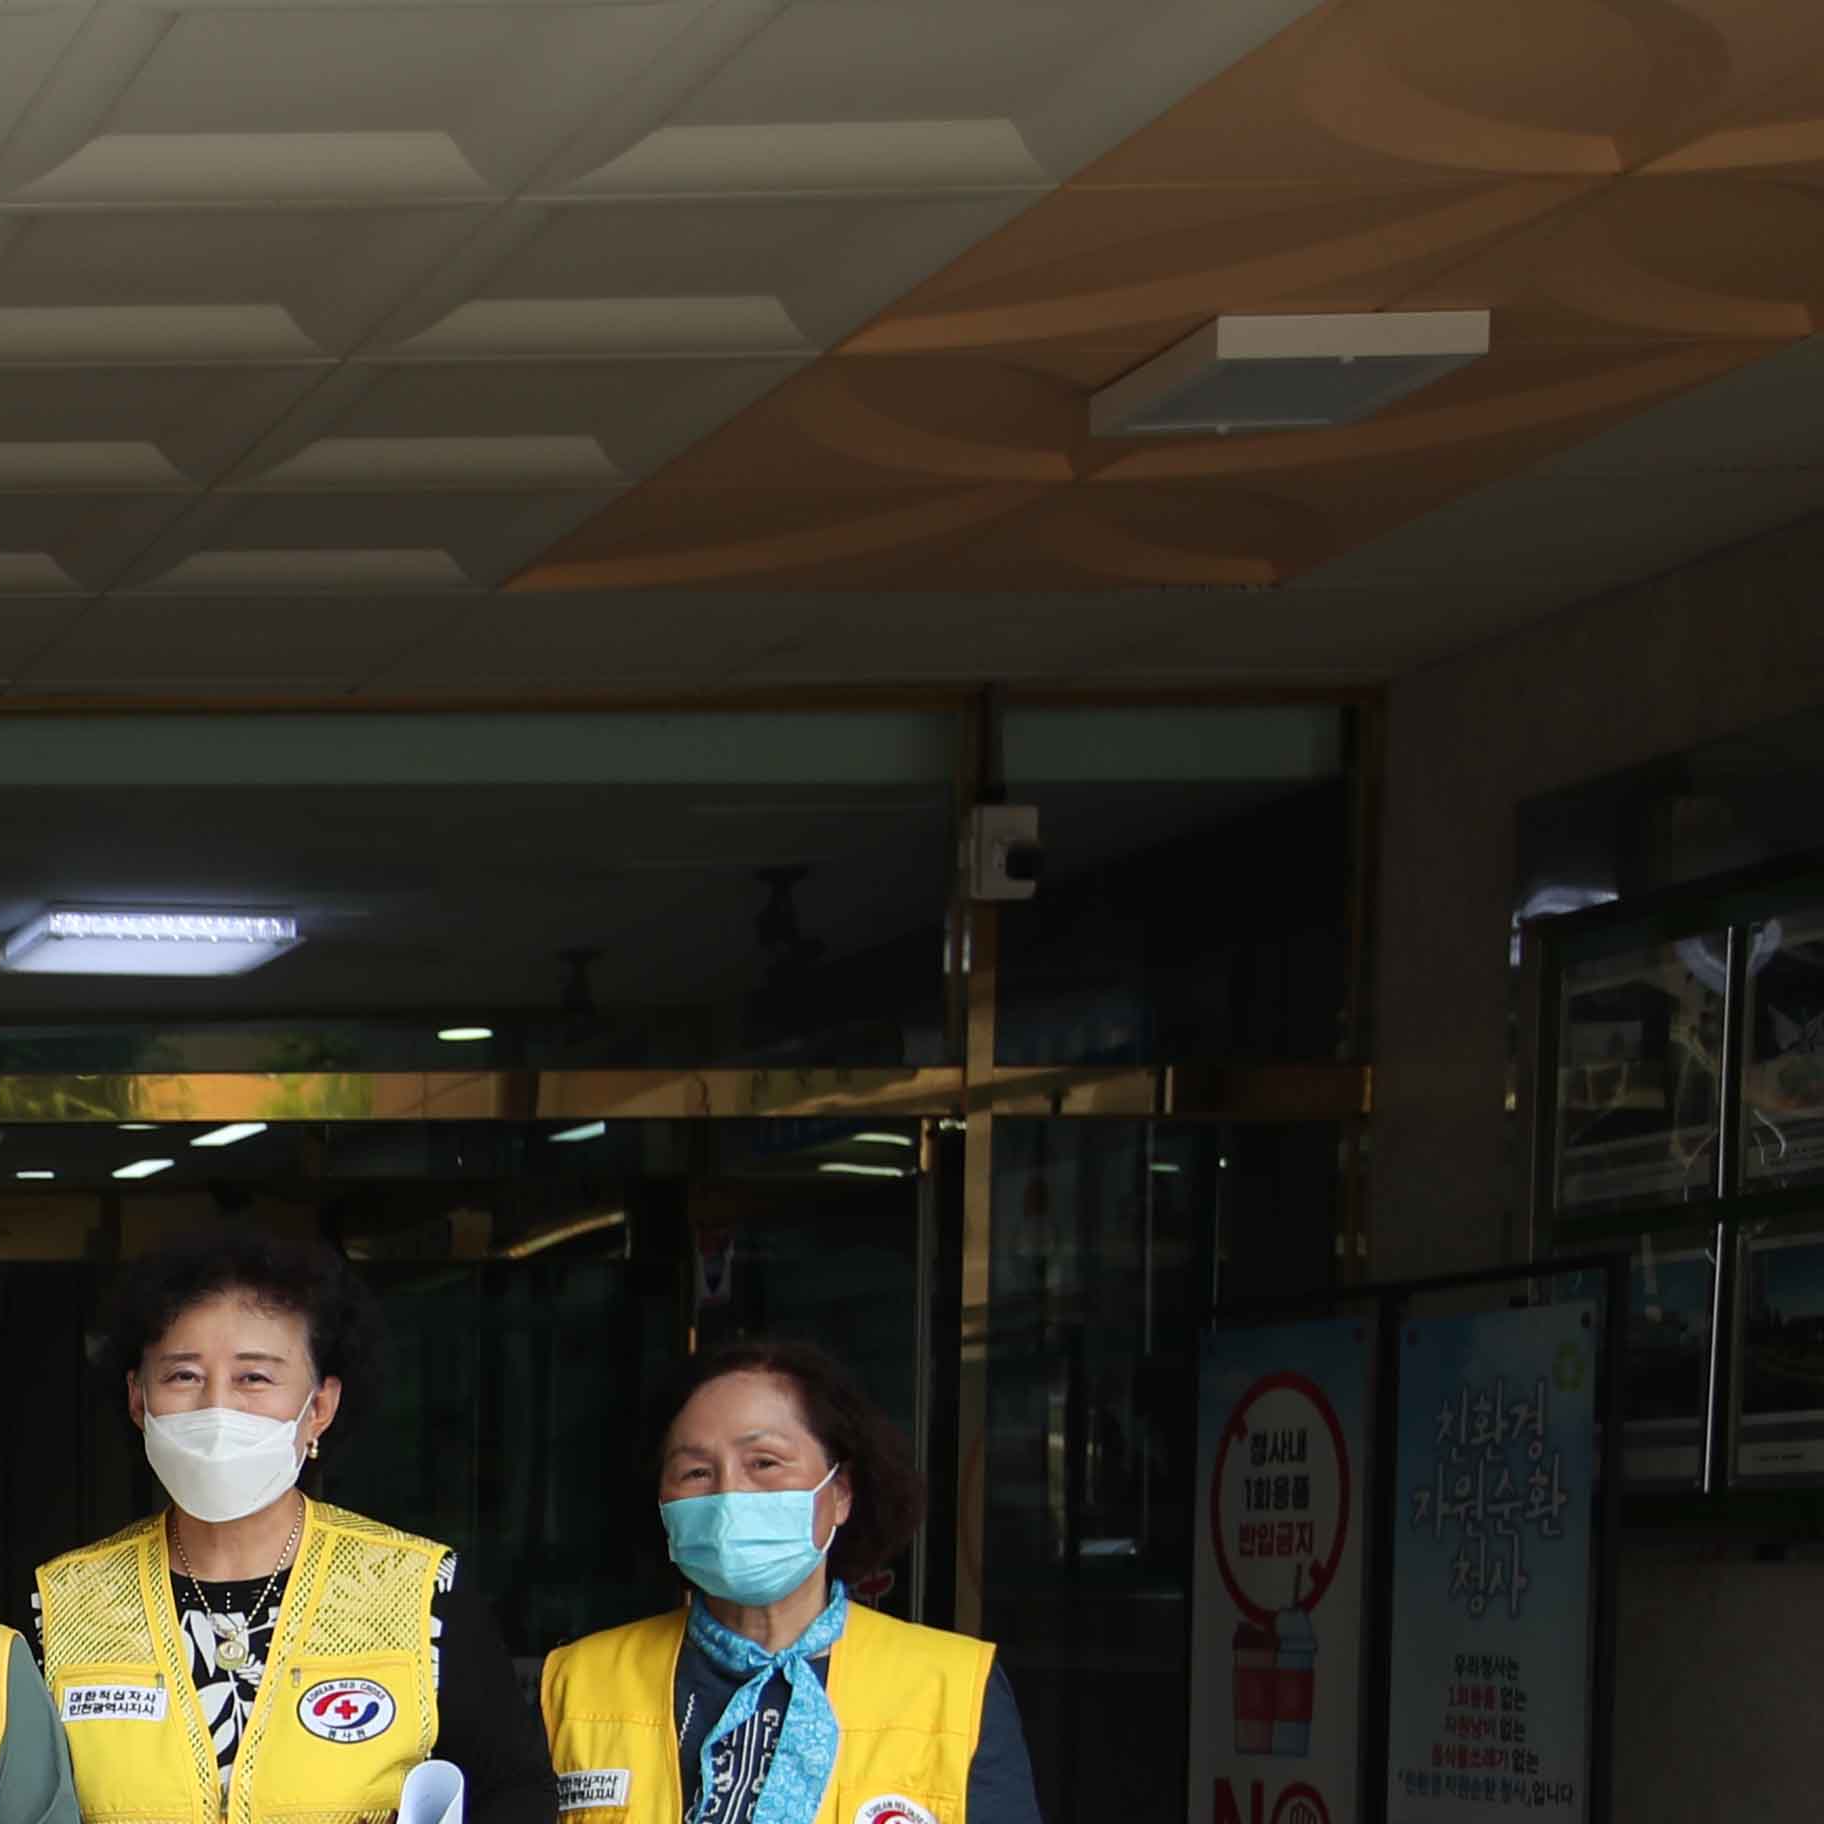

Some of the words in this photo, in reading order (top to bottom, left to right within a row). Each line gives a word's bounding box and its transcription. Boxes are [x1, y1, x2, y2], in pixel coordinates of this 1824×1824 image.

[1434, 1376, 1546, 1463] 친환경
[1410, 1452, 1568, 1540] 자원순환
[1450, 1533, 1529, 1616] 청사
[70, 1690, 156, 1703] 대한적십자사
